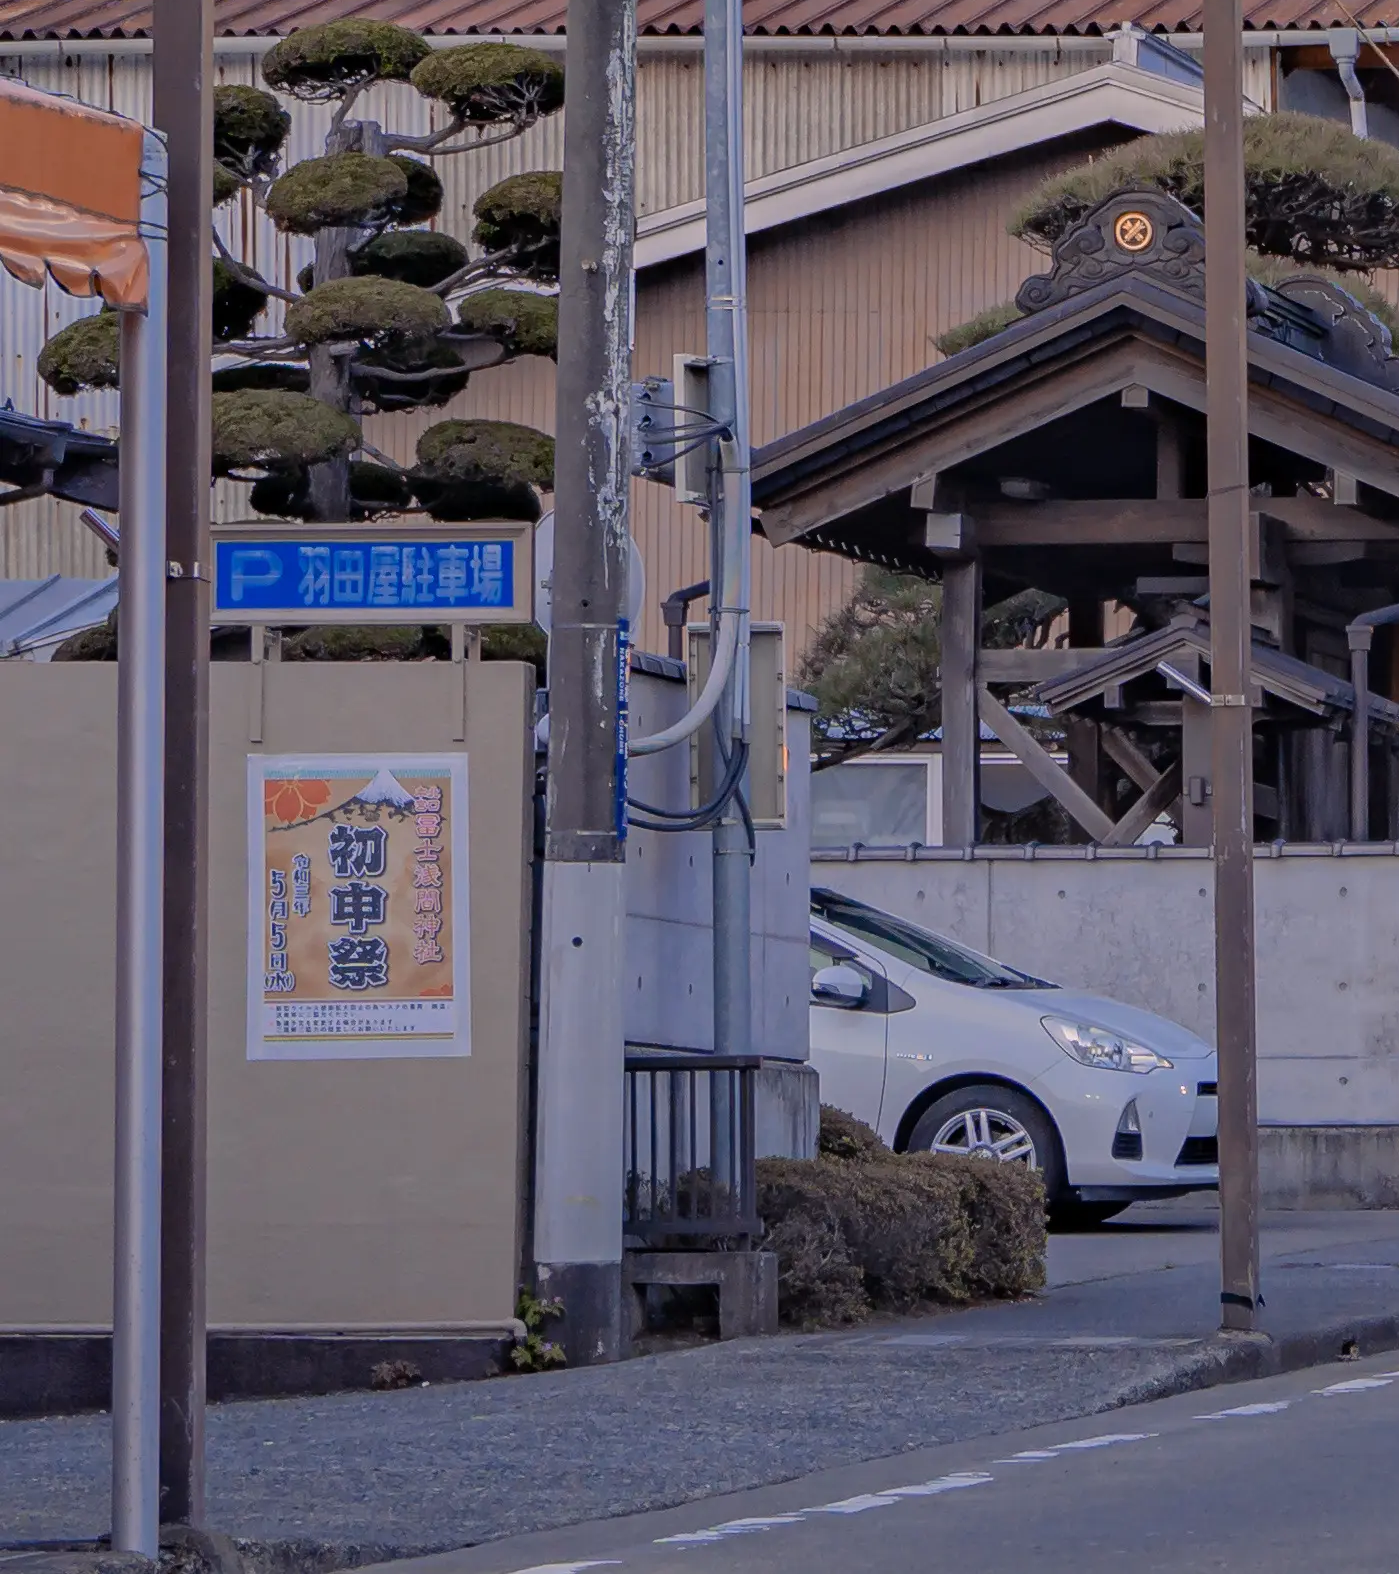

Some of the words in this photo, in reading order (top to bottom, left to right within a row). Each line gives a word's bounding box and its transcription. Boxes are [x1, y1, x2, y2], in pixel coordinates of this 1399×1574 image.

[231, 550, 283, 601] P
[298, 544, 503, 605] 羽田屋駐車場
[328, 823, 389, 990] 初申祭
